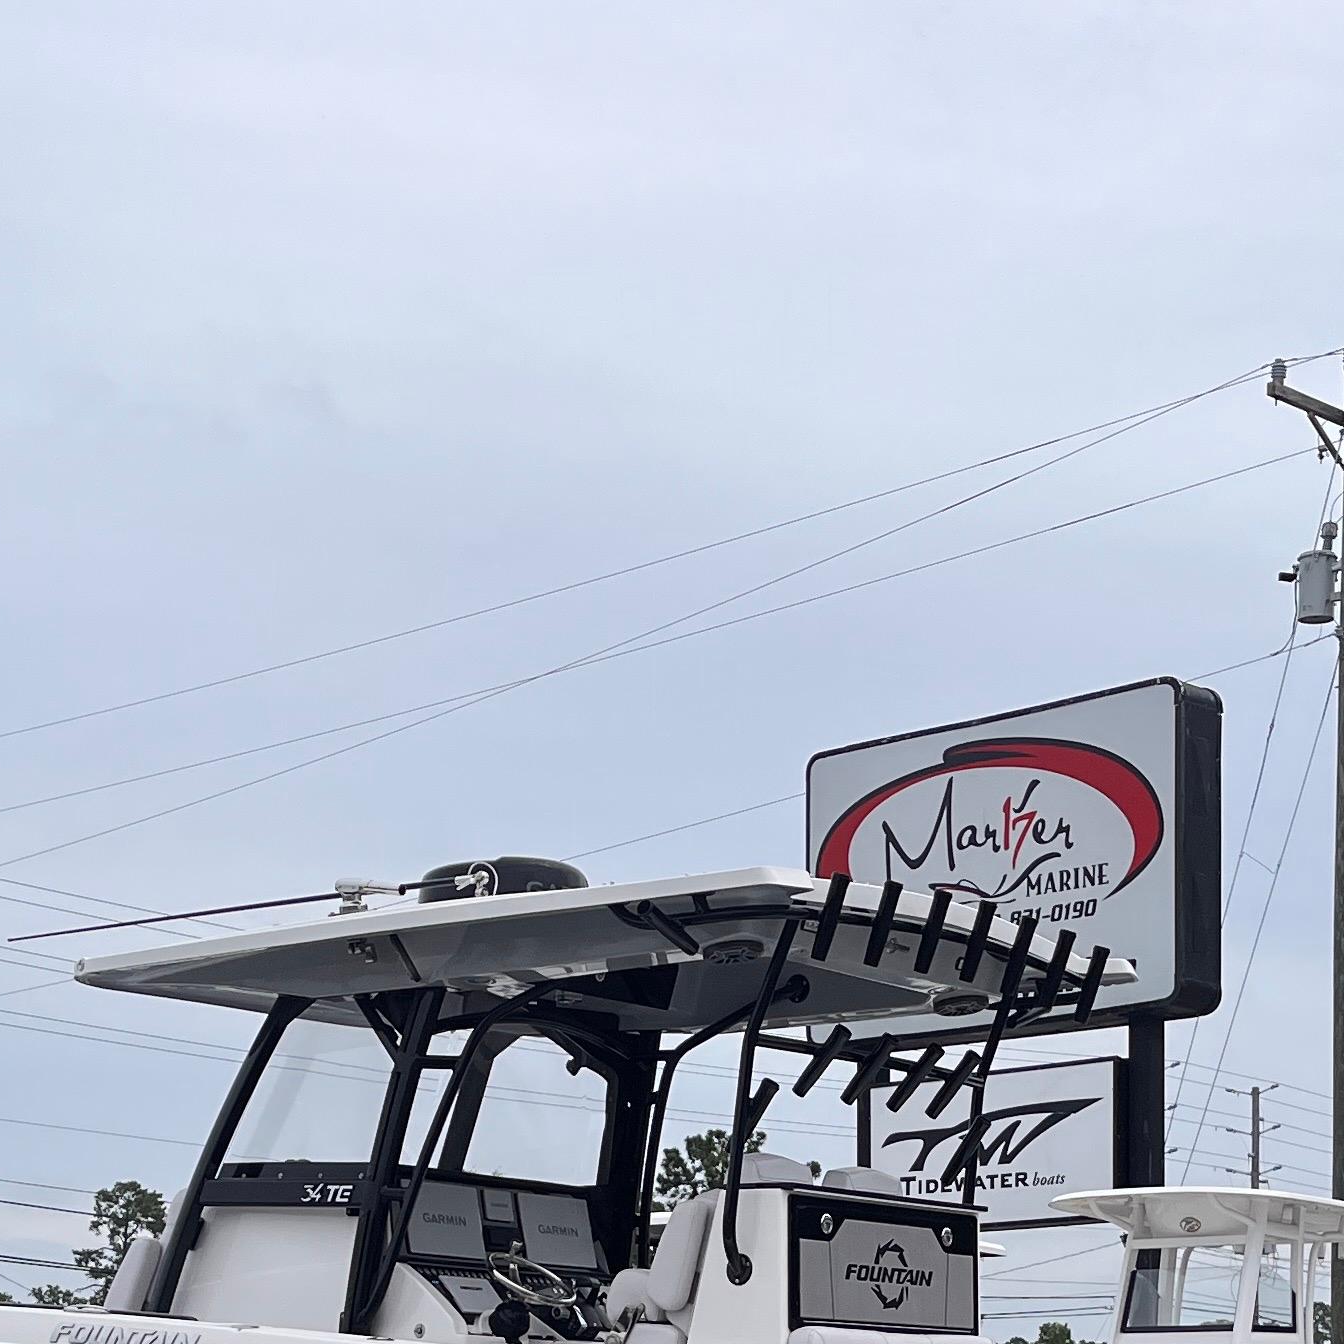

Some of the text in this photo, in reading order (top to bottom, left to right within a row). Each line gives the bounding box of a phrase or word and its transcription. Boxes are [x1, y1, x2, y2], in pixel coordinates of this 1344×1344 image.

[1025, 863, 1110, 898] MARINE
[1032, 1171, 1066, 1187] boats
[422, 1212, 468, 1228] GARMIN
[537, 1223, 580, 1239] GARMIN
[844, 1263, 934, 1288] FOUNTAIN
